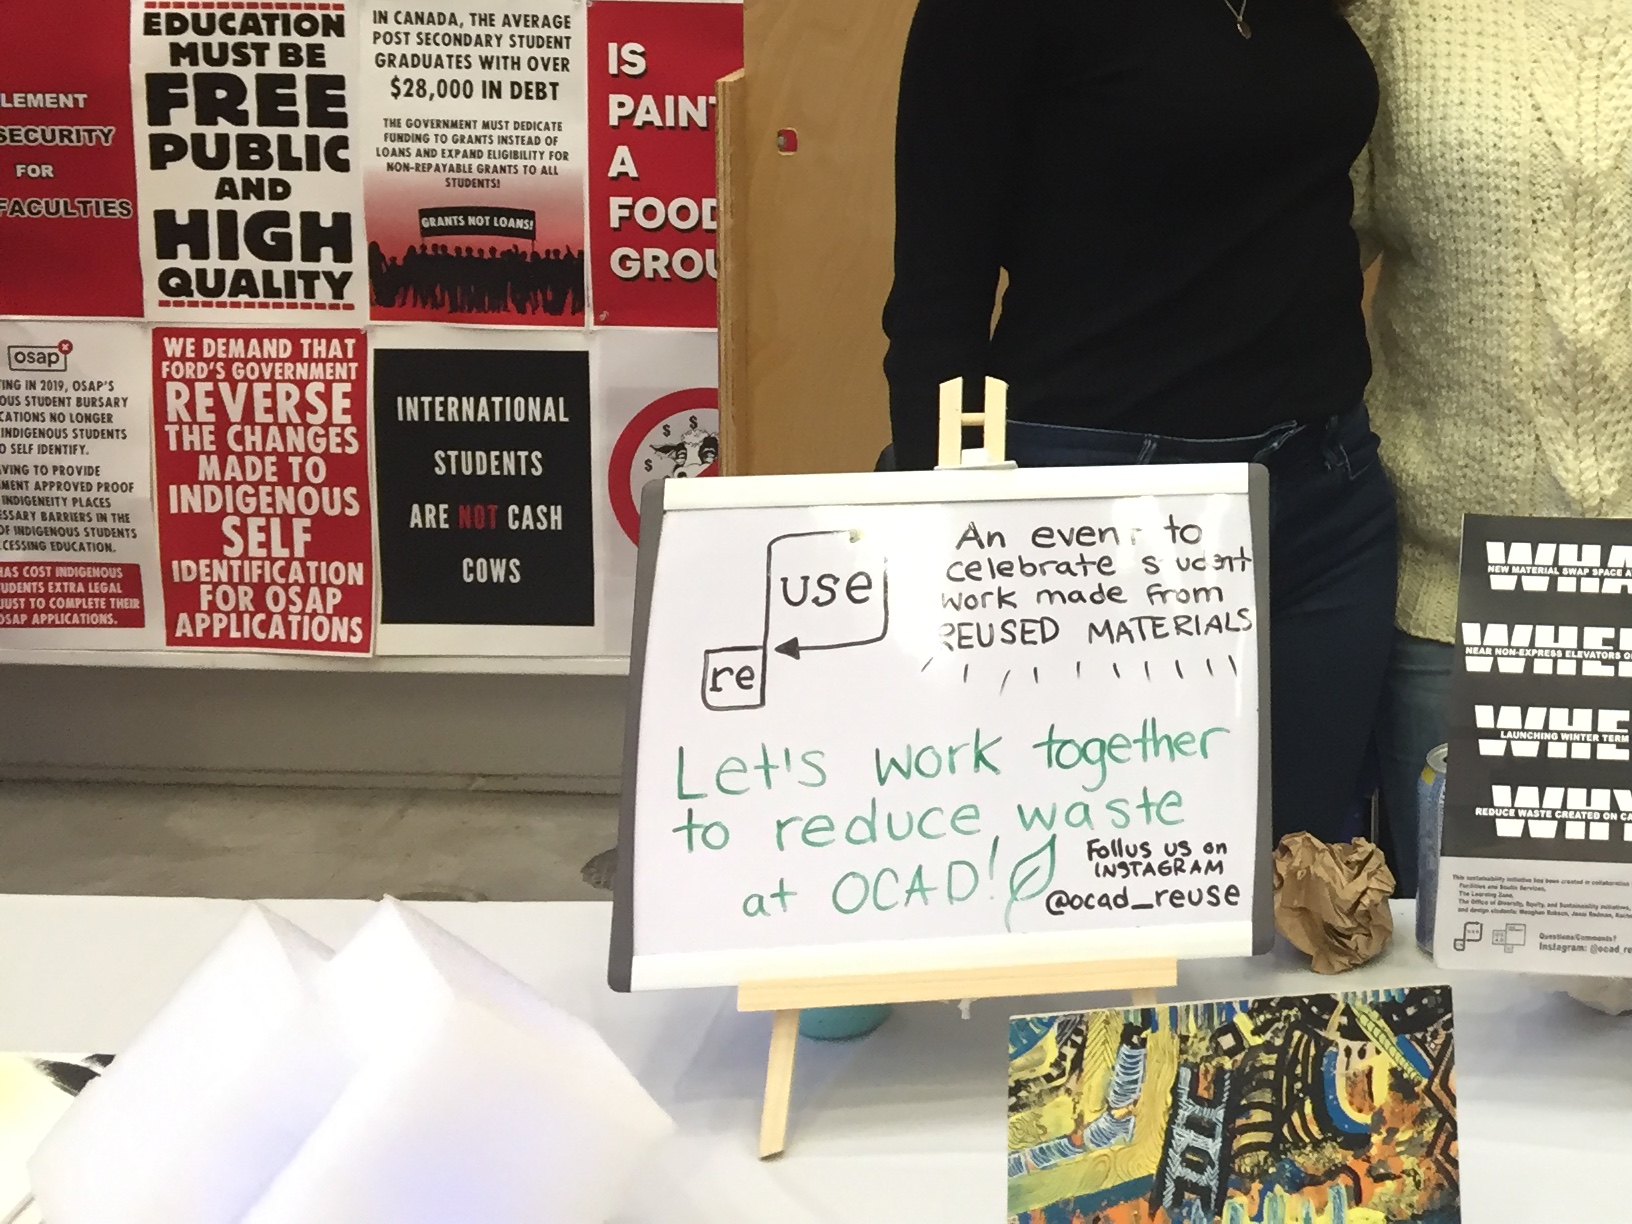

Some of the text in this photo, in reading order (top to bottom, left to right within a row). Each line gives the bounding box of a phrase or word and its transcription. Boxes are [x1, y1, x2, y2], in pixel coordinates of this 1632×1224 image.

[373, 10, 570, 29] IN CANADA, THE AVERAGE
[373, 31, 571, 49] POST SECONDARY STUDENT
[375, 53, 569, 72] GRADUATES WITH OVER
[391, 75, 559, 101] $28,000 IN DEBT
[421, 216, 533, 230] GRANTS NOT LOANS!
[163, 337, 355, 358] WE DEMAND THAT
[162, 361, 358, 380] FORD'S GOVERNMENT
[166, 382, 351, 424] REVERSE
[398, 397, 569, 422] INTERNATIONAL
[165, 424, 359, 454] THE CHANGES
[199, 455, 326, 483] MADE TO
[434, 450, 542, 476] STUDENTS
[169, 486, 361, 516] INDIGENOUS
[410, 504, 562, 530] ARE NOT CASH
[222, 516, 311, 557] SELF
[956, 522, 1006, 550] An
[1164, 514, 1202, 544] to
[171, 559, 364, 586] IDENTIFICATION
[463, 558, 520, 583] COWS
[947, 553, 1116, 582] celebrate
[1488, 565, 1510, 573] NEW
[1512, 566, 1559, 575] MATERIAL
[1562, 567, 1589, 575] SWAP
[1592, 568, 1623, 577] SPACE
[200, 584, 342, 614] FOR OSAP
[781, 572, 872, 607] use
[944, 583, 1223, 611] work made from
[175, 613, 362, 643] APPLICATIONS
[940, 608, 1252, 652] REUSED MATERIALS
[1466, 647, 1492, 655] NEAR
[1495, 648, 1562, 657] NON-EXPRESS
[1565, 650, 1620, 659] ELEVATORS
[708, 661, 756, 692] re
[1501, 731, 1558, 740] LAUNCHING
[1561, 732, 1599, 742] WINTER
[1602, 734, 1629, 743] TERM
[677, 717, 1230, 800] Let's work together
[672, 781, 1184, 852] to reduce waste
[1476, 807, 1515, 816] REDUCE
[1517, 808, 1553, 818] WASTE
[1555, 810, 1600, 820] CREATED
[1603, 812, 1617, 820] ON
[1087, 838, 1227, 861] Follus us on
[743, 825, 999, 917] at OCAD!
[1095, 858, 1223, 878] INSTAGRAM
[1046, 885, 1240, 915] @ocad_reuse
